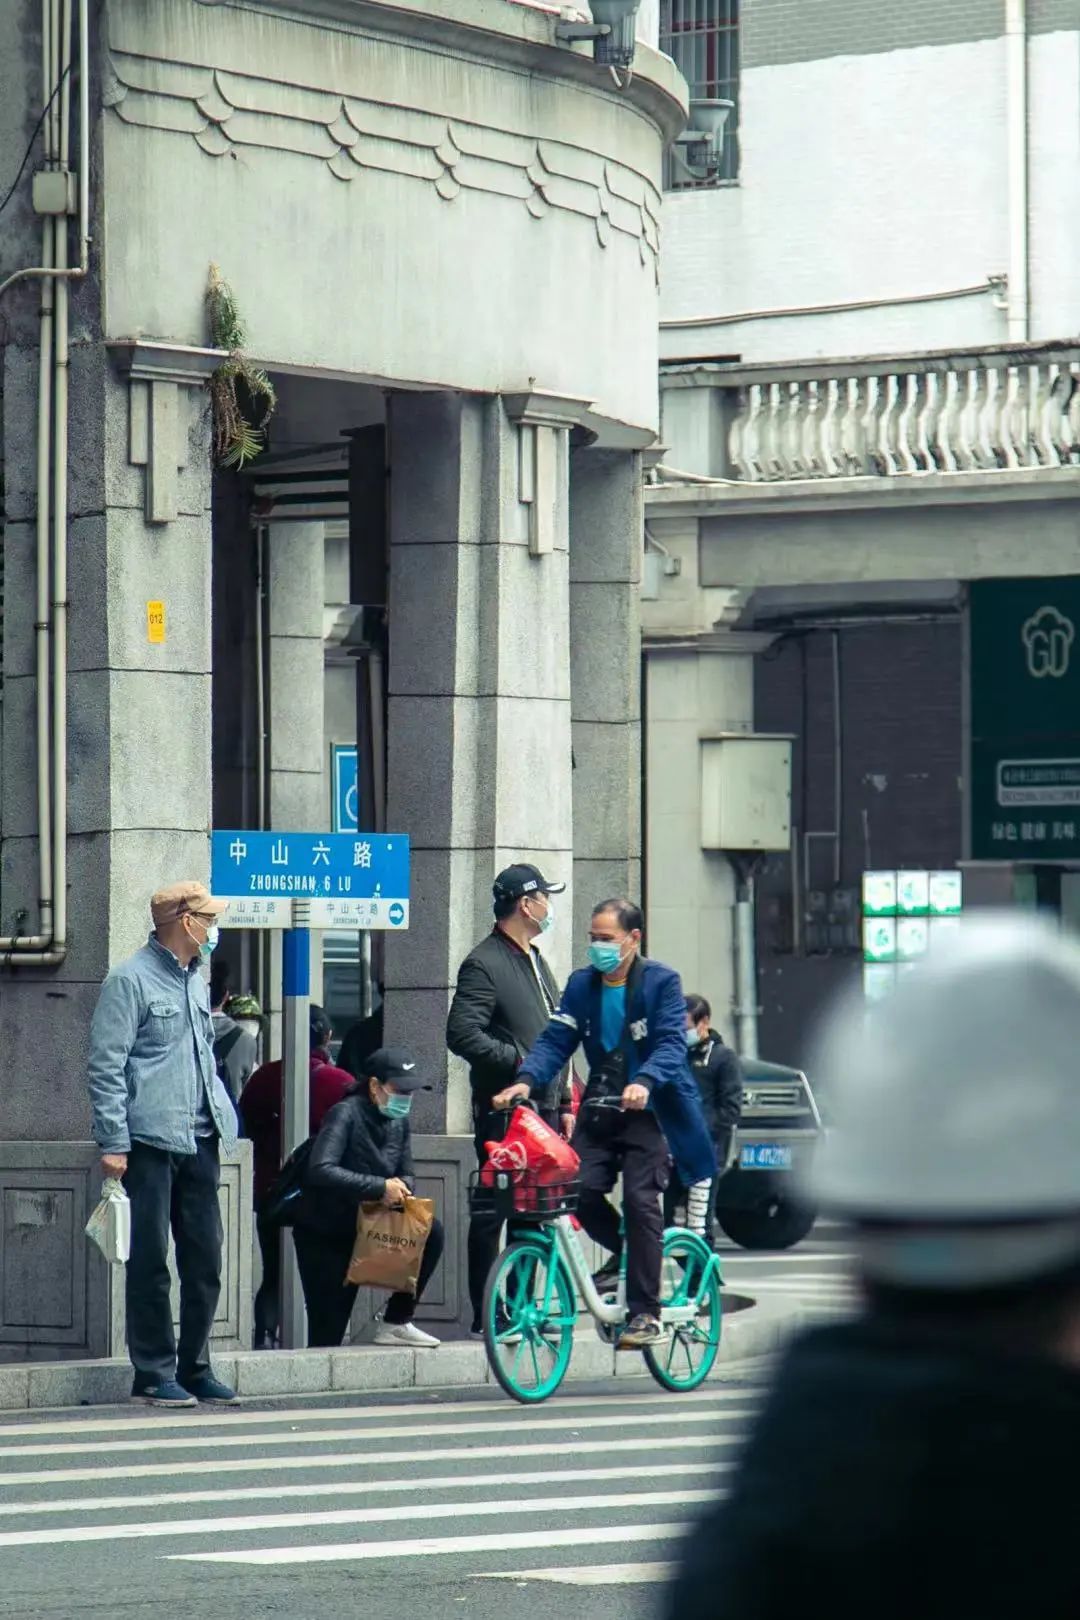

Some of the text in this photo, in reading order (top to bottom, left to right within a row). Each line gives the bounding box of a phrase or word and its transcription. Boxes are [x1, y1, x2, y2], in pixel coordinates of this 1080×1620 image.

[149, 613, 163, 625] 012
[229, 837, 373, 868] 中山六路
[249, 874, 352, 892] ZHONGSHAN 6 LU
[326, 902, 379, 916] 中山七路
[367, 1230, 417, 1248] FASHION
